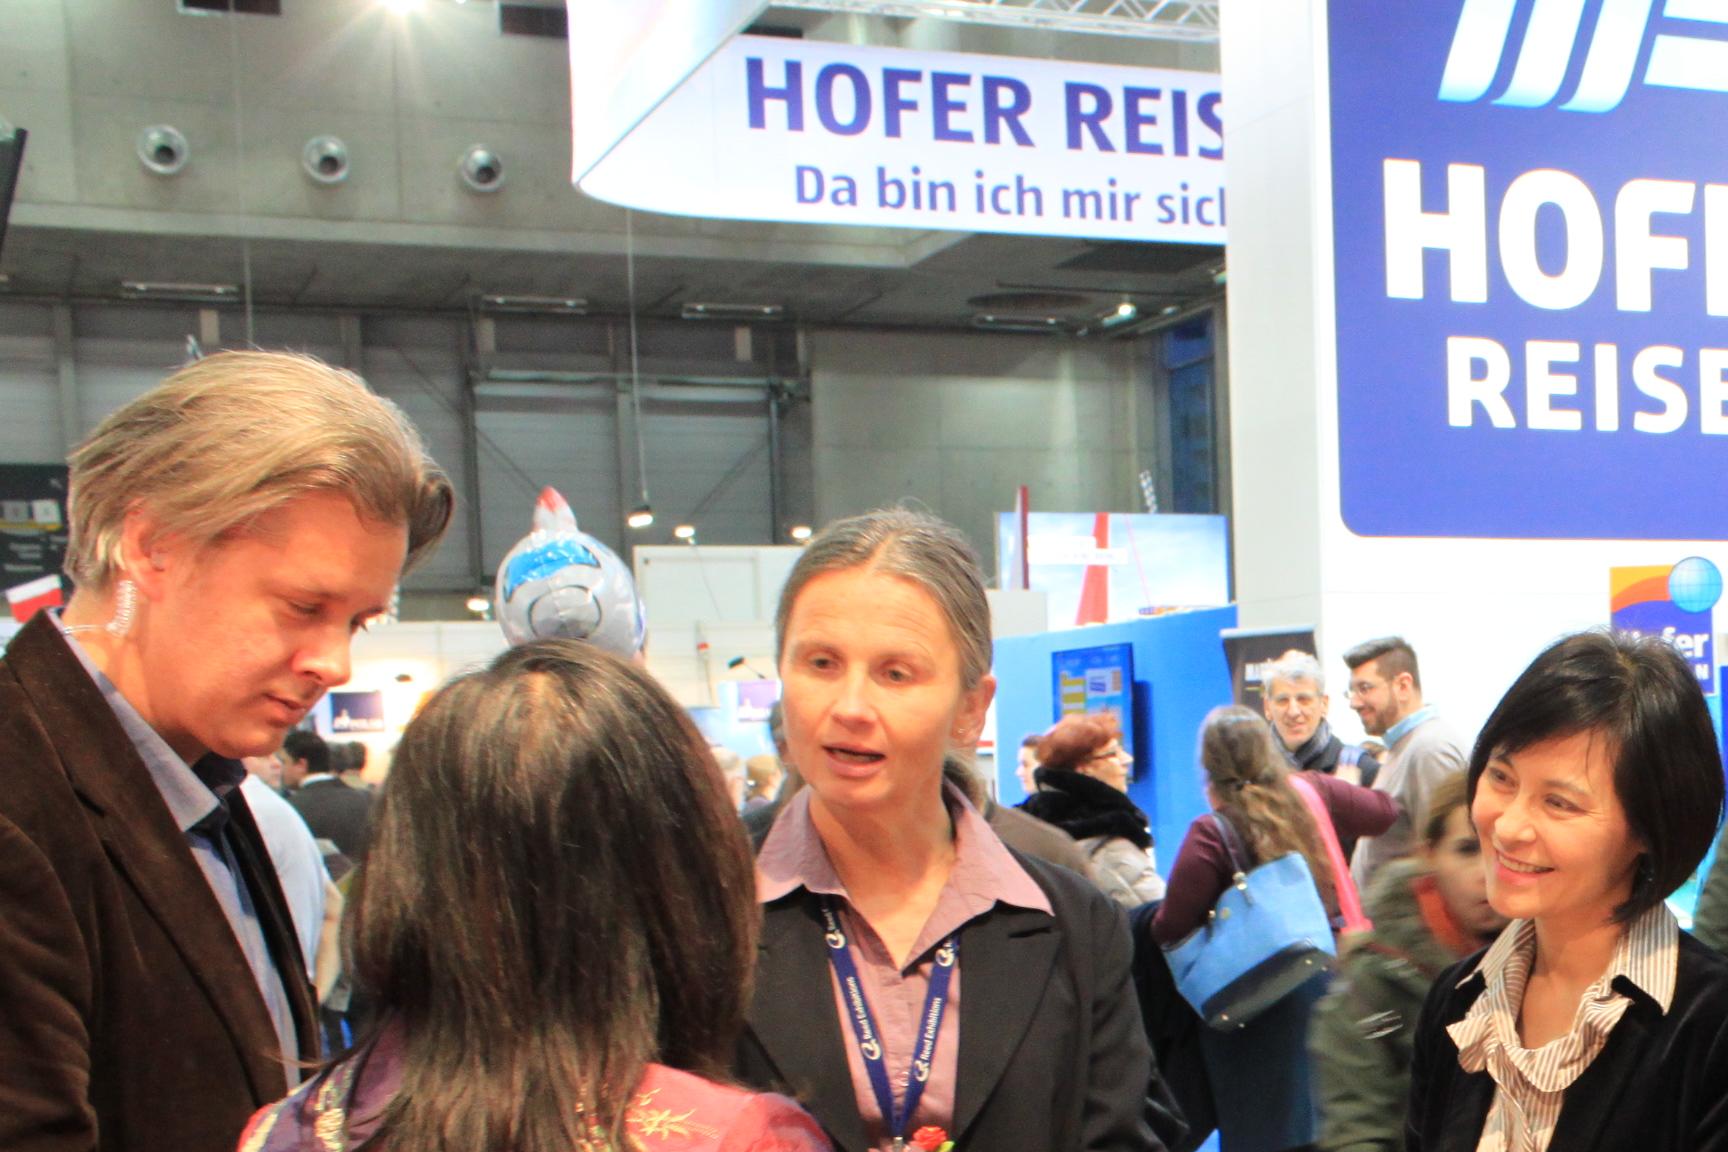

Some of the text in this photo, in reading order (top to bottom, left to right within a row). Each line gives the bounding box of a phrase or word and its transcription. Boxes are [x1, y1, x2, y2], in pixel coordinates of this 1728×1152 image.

[746, 57, 1225, 161] HOFER REIS
[795, 164, 858, 207] Da
[877, 165, 957, 213] bin
[974, 169, 1044, 217] ich
[1062, 177, 1141, 223] mir
